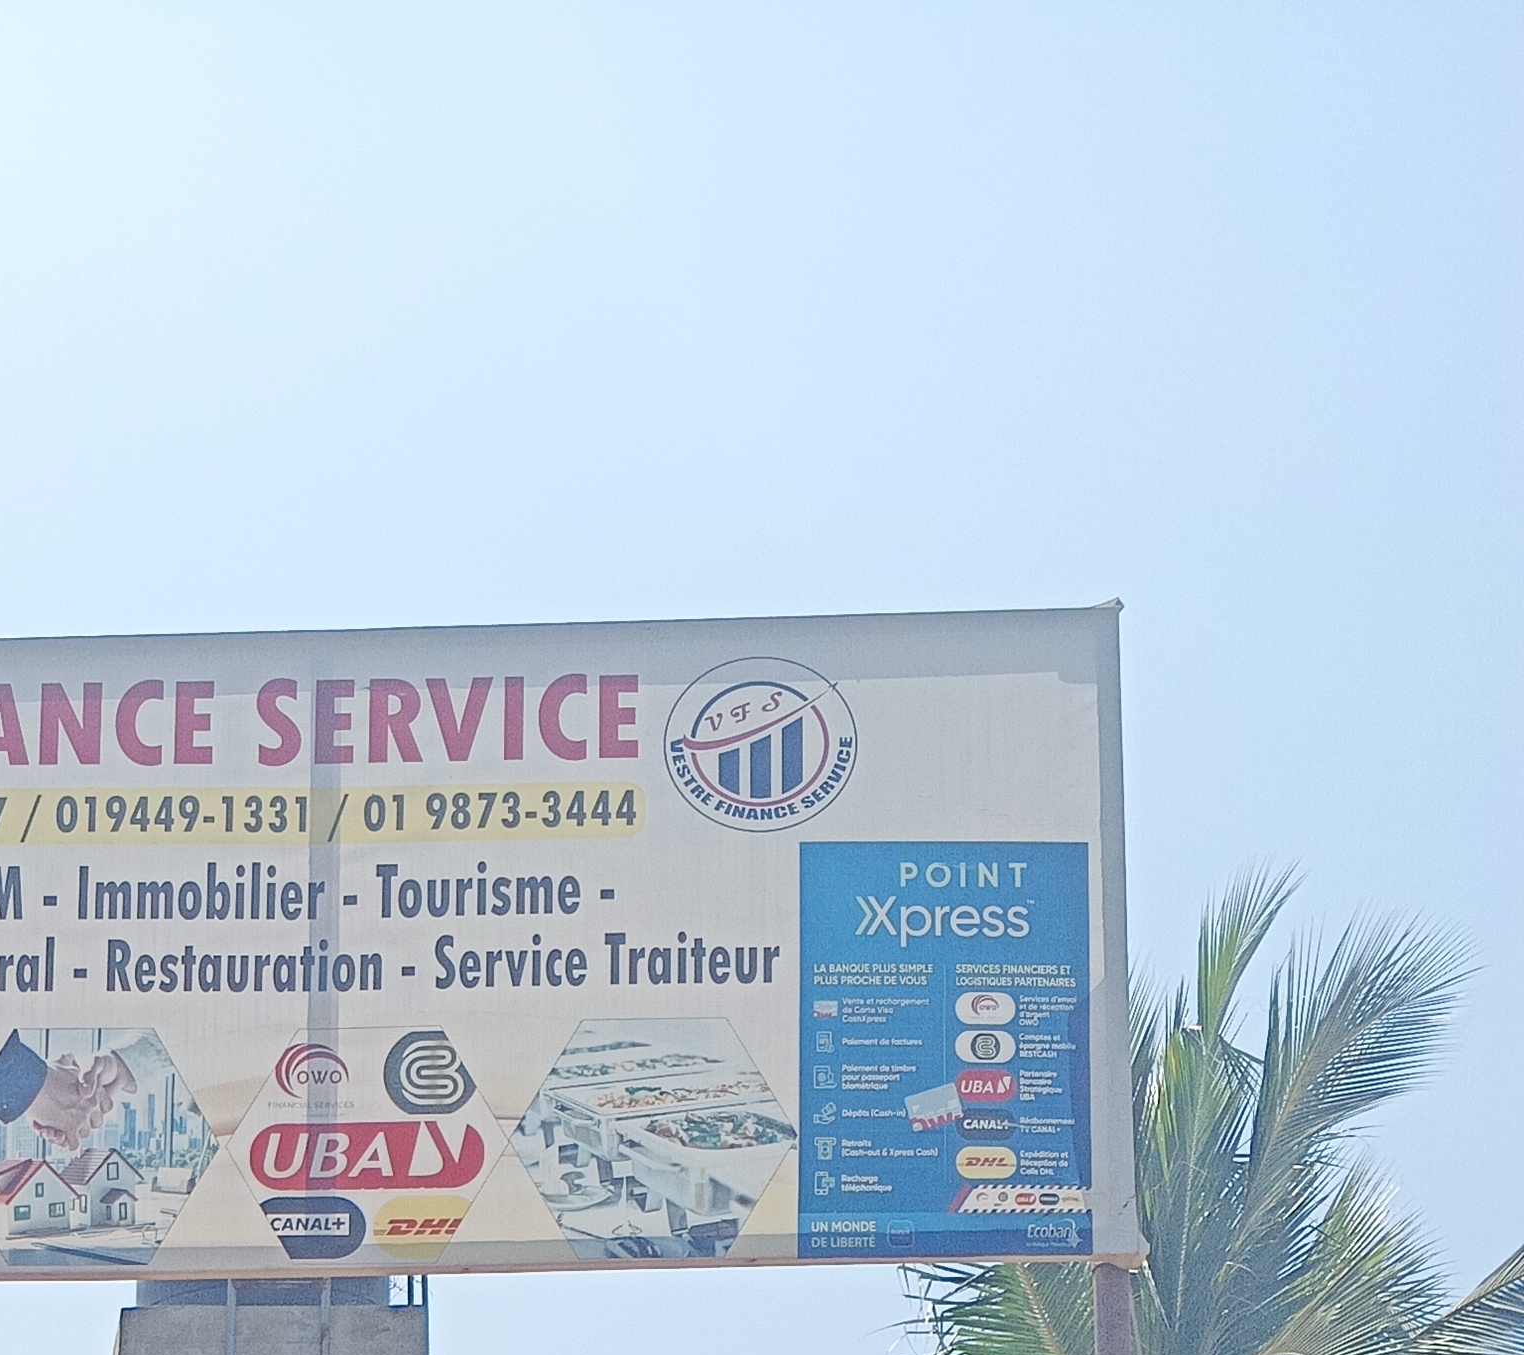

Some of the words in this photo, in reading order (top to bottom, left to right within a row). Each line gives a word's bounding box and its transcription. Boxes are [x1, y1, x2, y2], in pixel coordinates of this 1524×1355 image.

[256, 673, 639, 767] SERVICE
[671, 738, 714, 806] VESTRE
[715, 800, 799, 820] FINANCE
[802, 736, 852, 809] SERVICE
[56, 795, 307, 834] 019449-1331
[426, 789, 637, 830] 9873-3444
[900, 862, 1027, 888] POINT
[78, 862, 325, 921] Immobilier
[376, 861, 580, 919] Tourisme
[106, 938, 383, 993] Restauration
[434, 933, 588, 989] Service
[604, 931, 780, 986] Traiteur
[813, 964, 826, 973] LA
[829, 964, 870, 974] BANQUE
[872, 964, 896, 973] PLUS
[899, 964, 934, 974] SIMPLE
[956, 964, 1000, 974] SERVICES
[1003, 965, 1058, 974] FINANCIERS
[1061, 965, 1071, 974] ET
[813, 976, 838, 985] PLUS
[841, 976, 881, 985] PROCHE
[884, 976, 897, 985] DE
[900, 976, 927, 985] VOUS
[956, 977, 1012, 986] LOGISTIQUES
[1015, 977, 1076, 987] PARTENAIRES
[961, 1081, 993, 1093] UBA
[263, 1131, 394, 1179] UBA
[965, 1157, 1009, 1167] DHL
[270, 1216, 346, 1232] CANAL+
[812, 1221, 828, 1232] UN
[831, 1221, 876, 1232] MONDE
[1027, 1220, 1079, 1239] Ecobank
[812, 1236, 827, 1247] DE
[830, 1235, 876, 1247] LIBERTÉ
